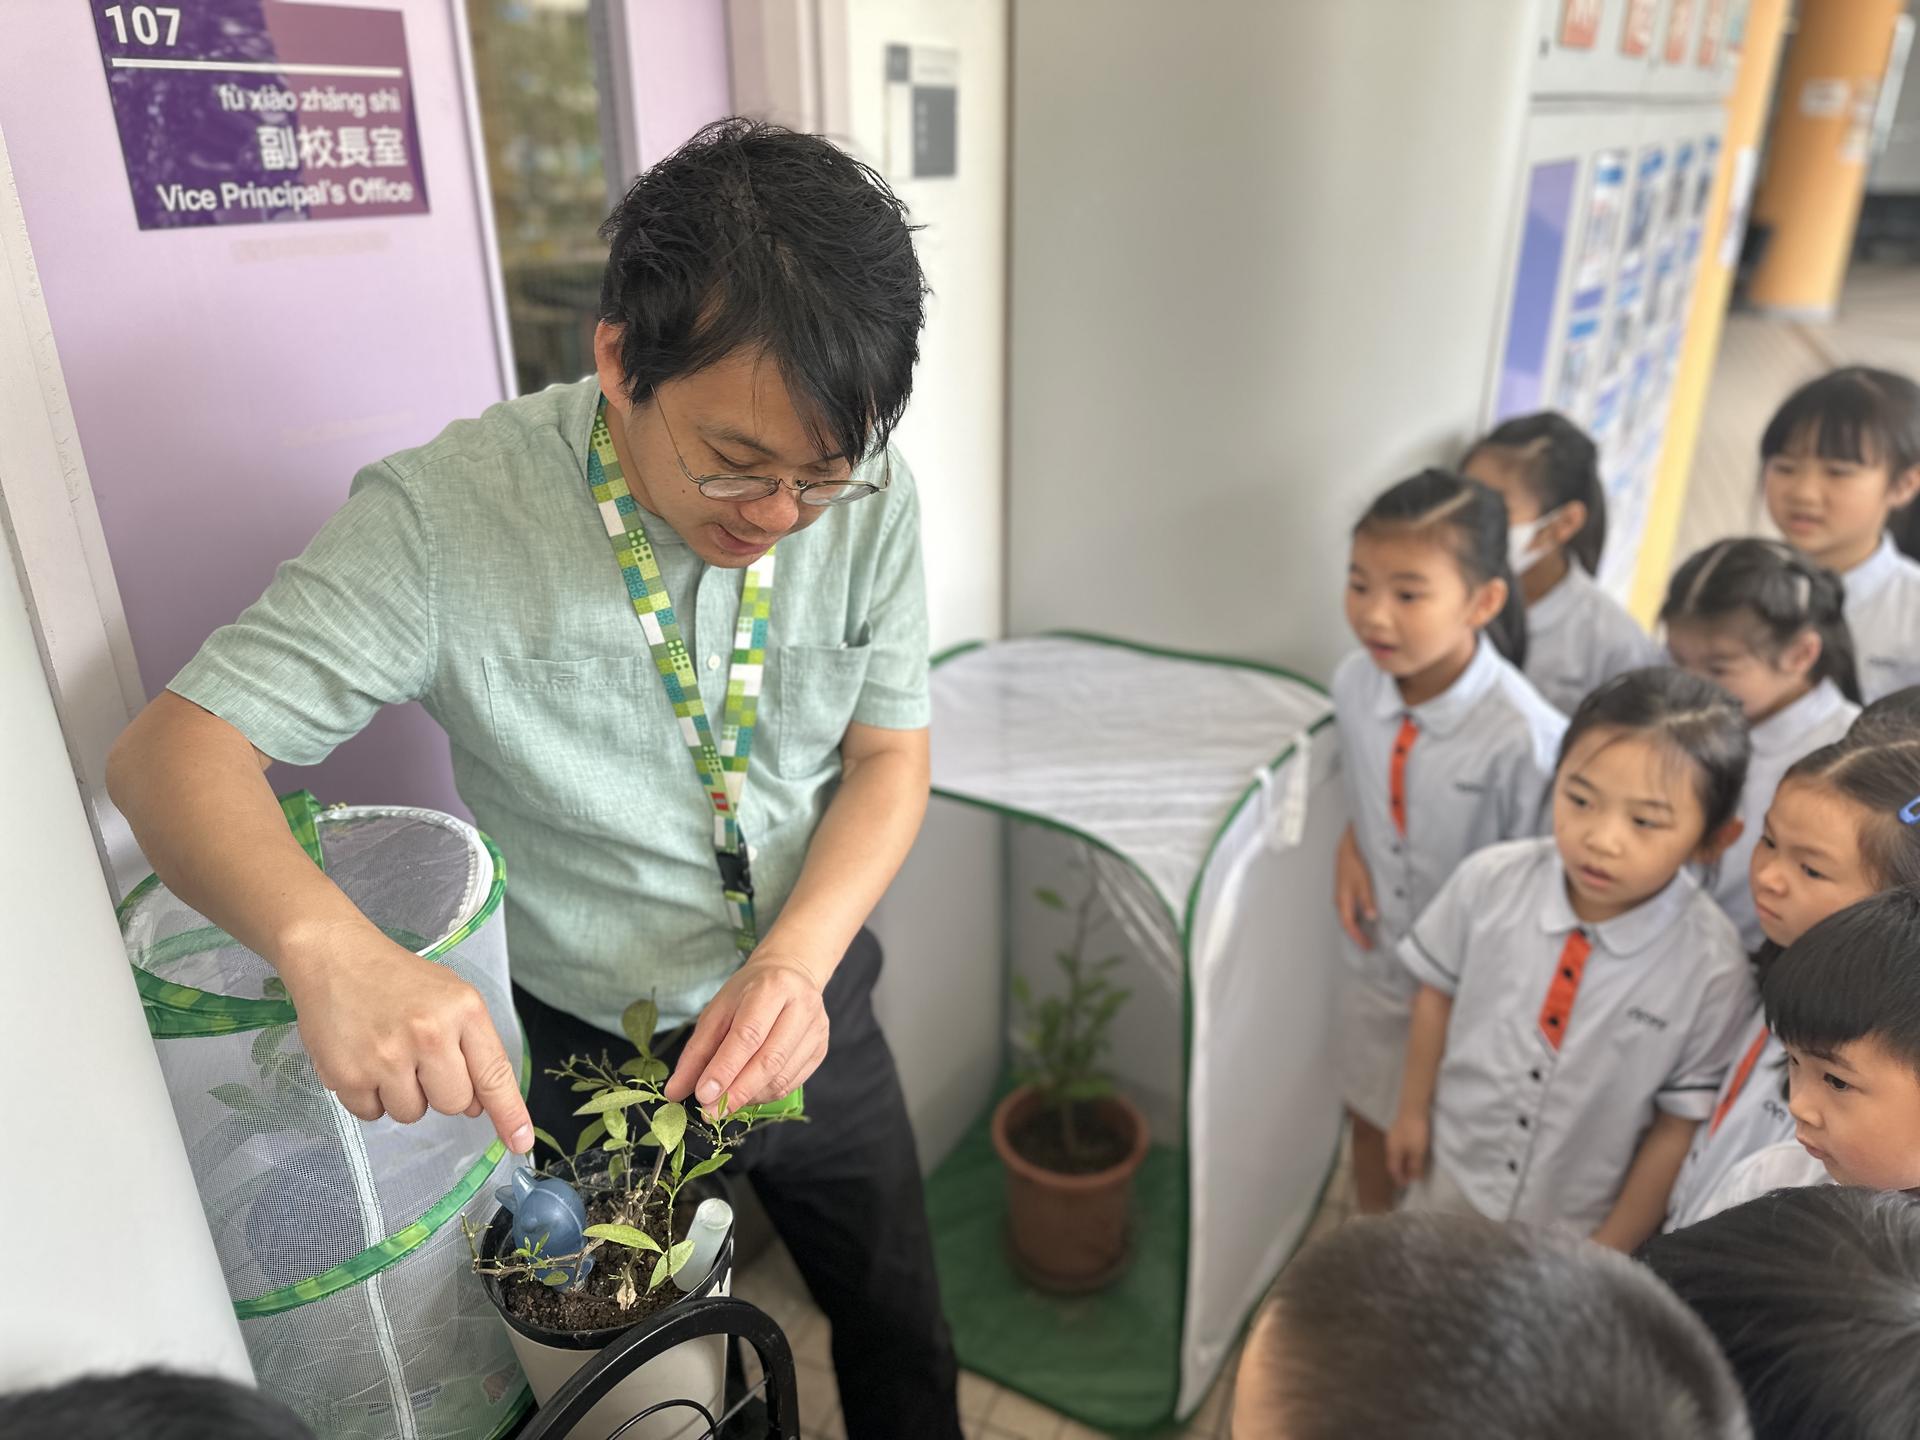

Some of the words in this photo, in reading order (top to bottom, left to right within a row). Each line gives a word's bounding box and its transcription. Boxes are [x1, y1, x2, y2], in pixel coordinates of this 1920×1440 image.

[105, 5, 180, 46] 107
[259, 126, 406, 170] 副校長室
[157, 185, 217, 212] Vice
[349, 178, 413, 205] Office
